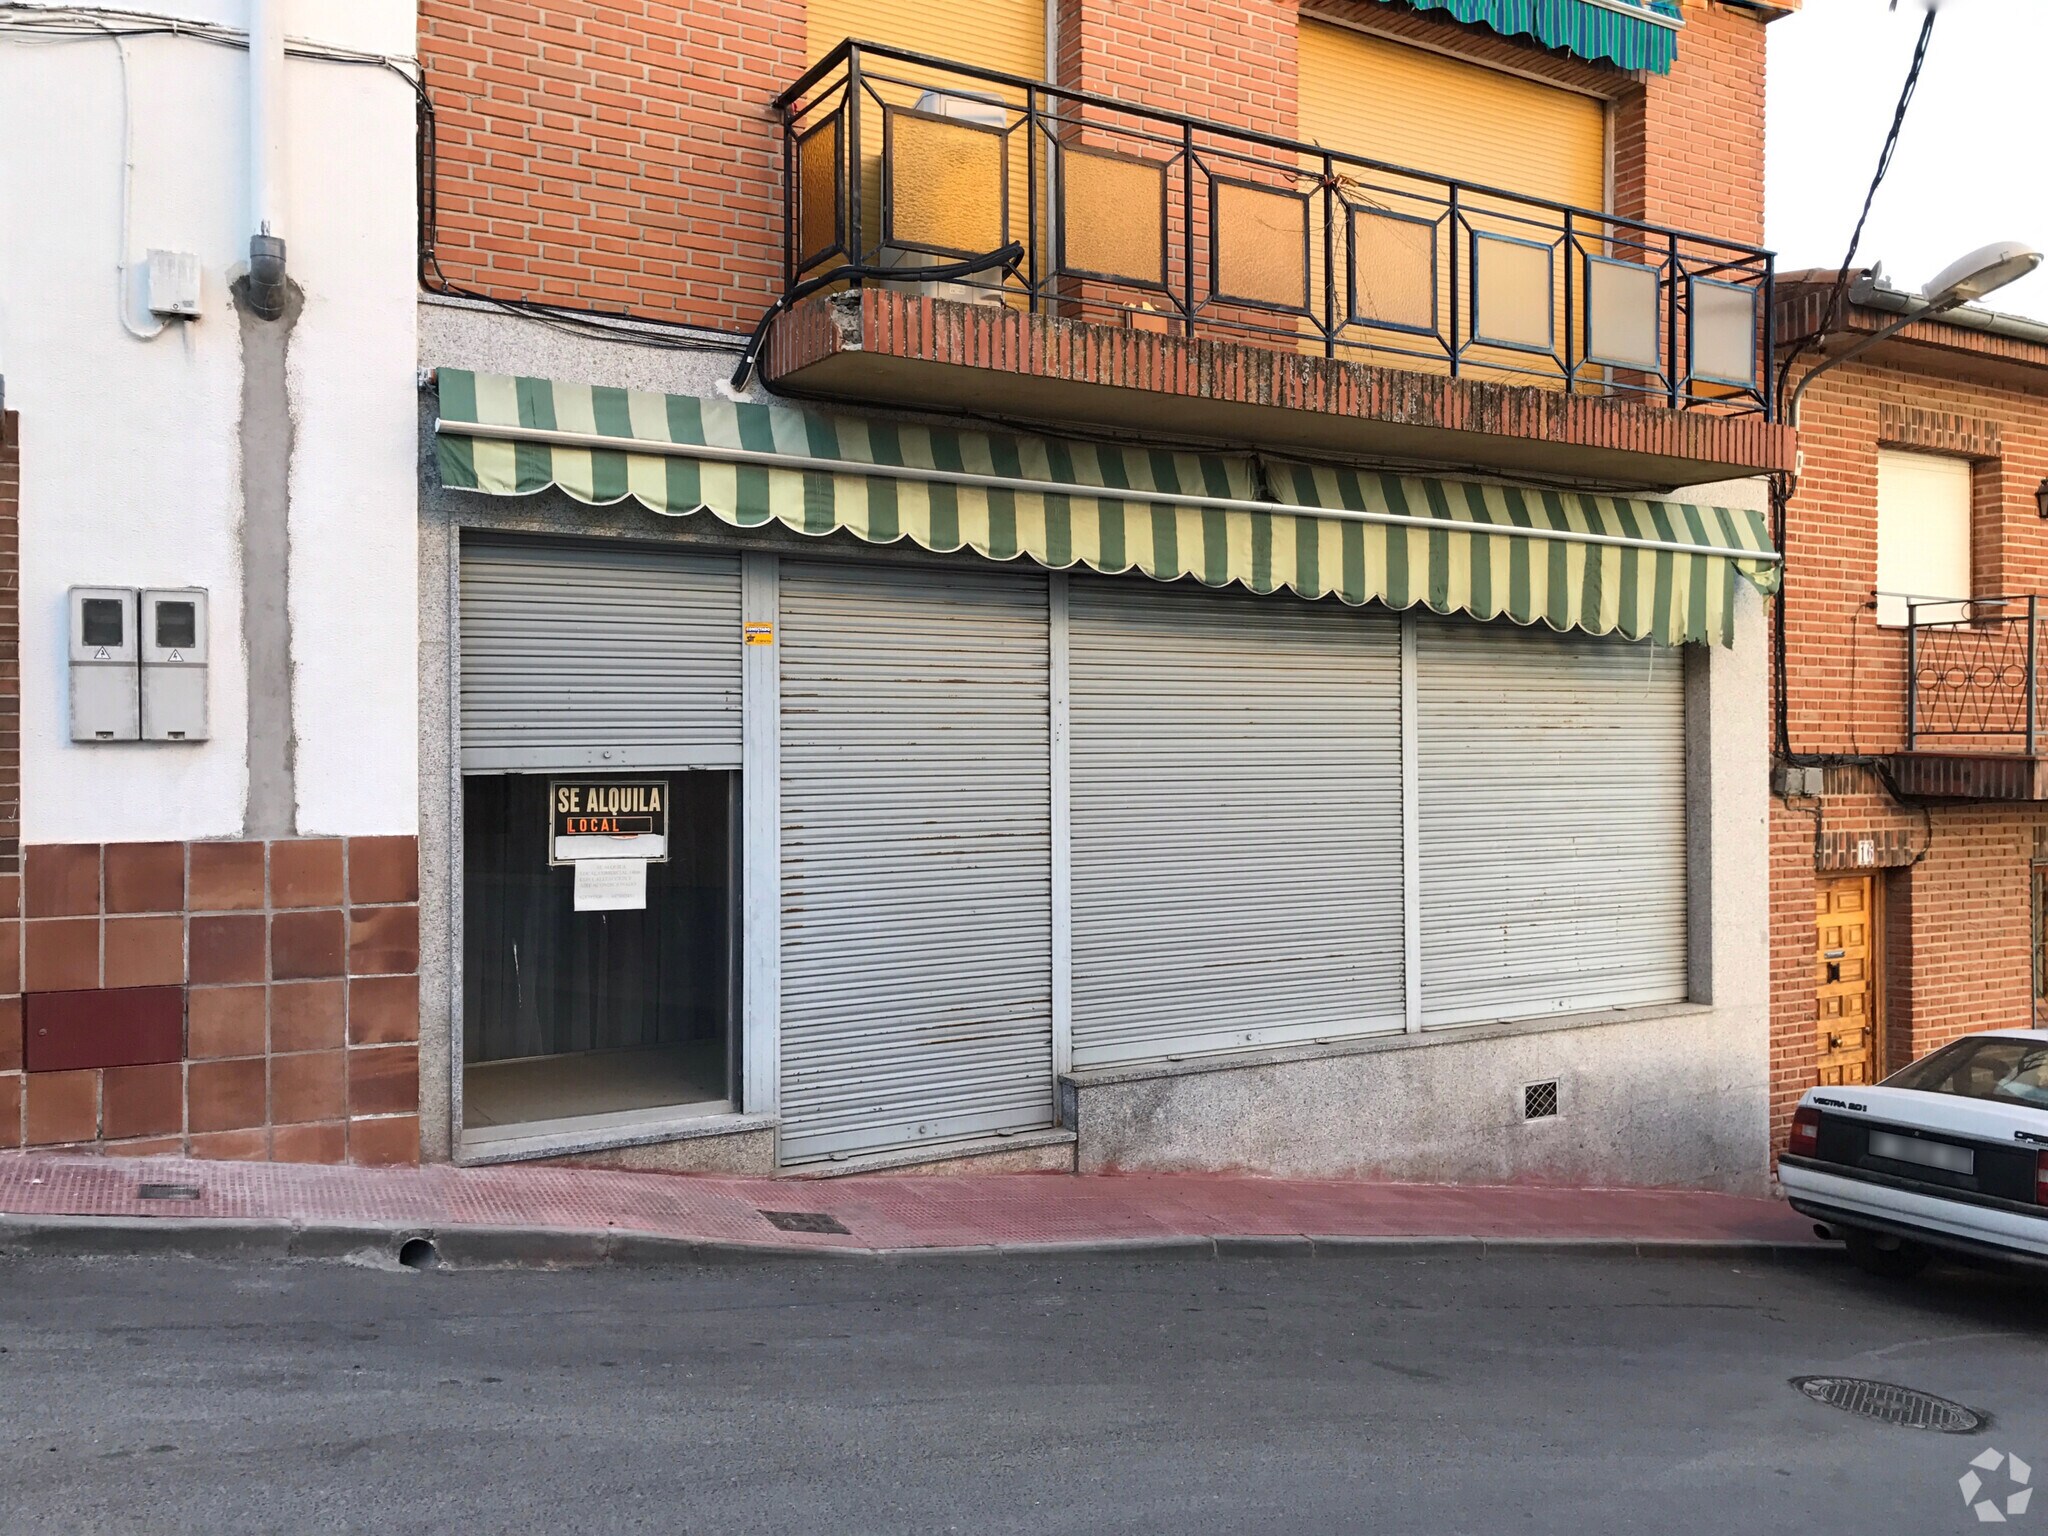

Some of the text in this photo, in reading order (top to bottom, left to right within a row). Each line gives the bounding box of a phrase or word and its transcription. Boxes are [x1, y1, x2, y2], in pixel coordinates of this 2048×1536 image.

[558, 787, 661, 815] SE ALQUILA
[568, 818, 620, 833] LOCAL
[1860, 844, 1873, 862] 16
[1813, 1096, 1847, 1109] VECTRA
